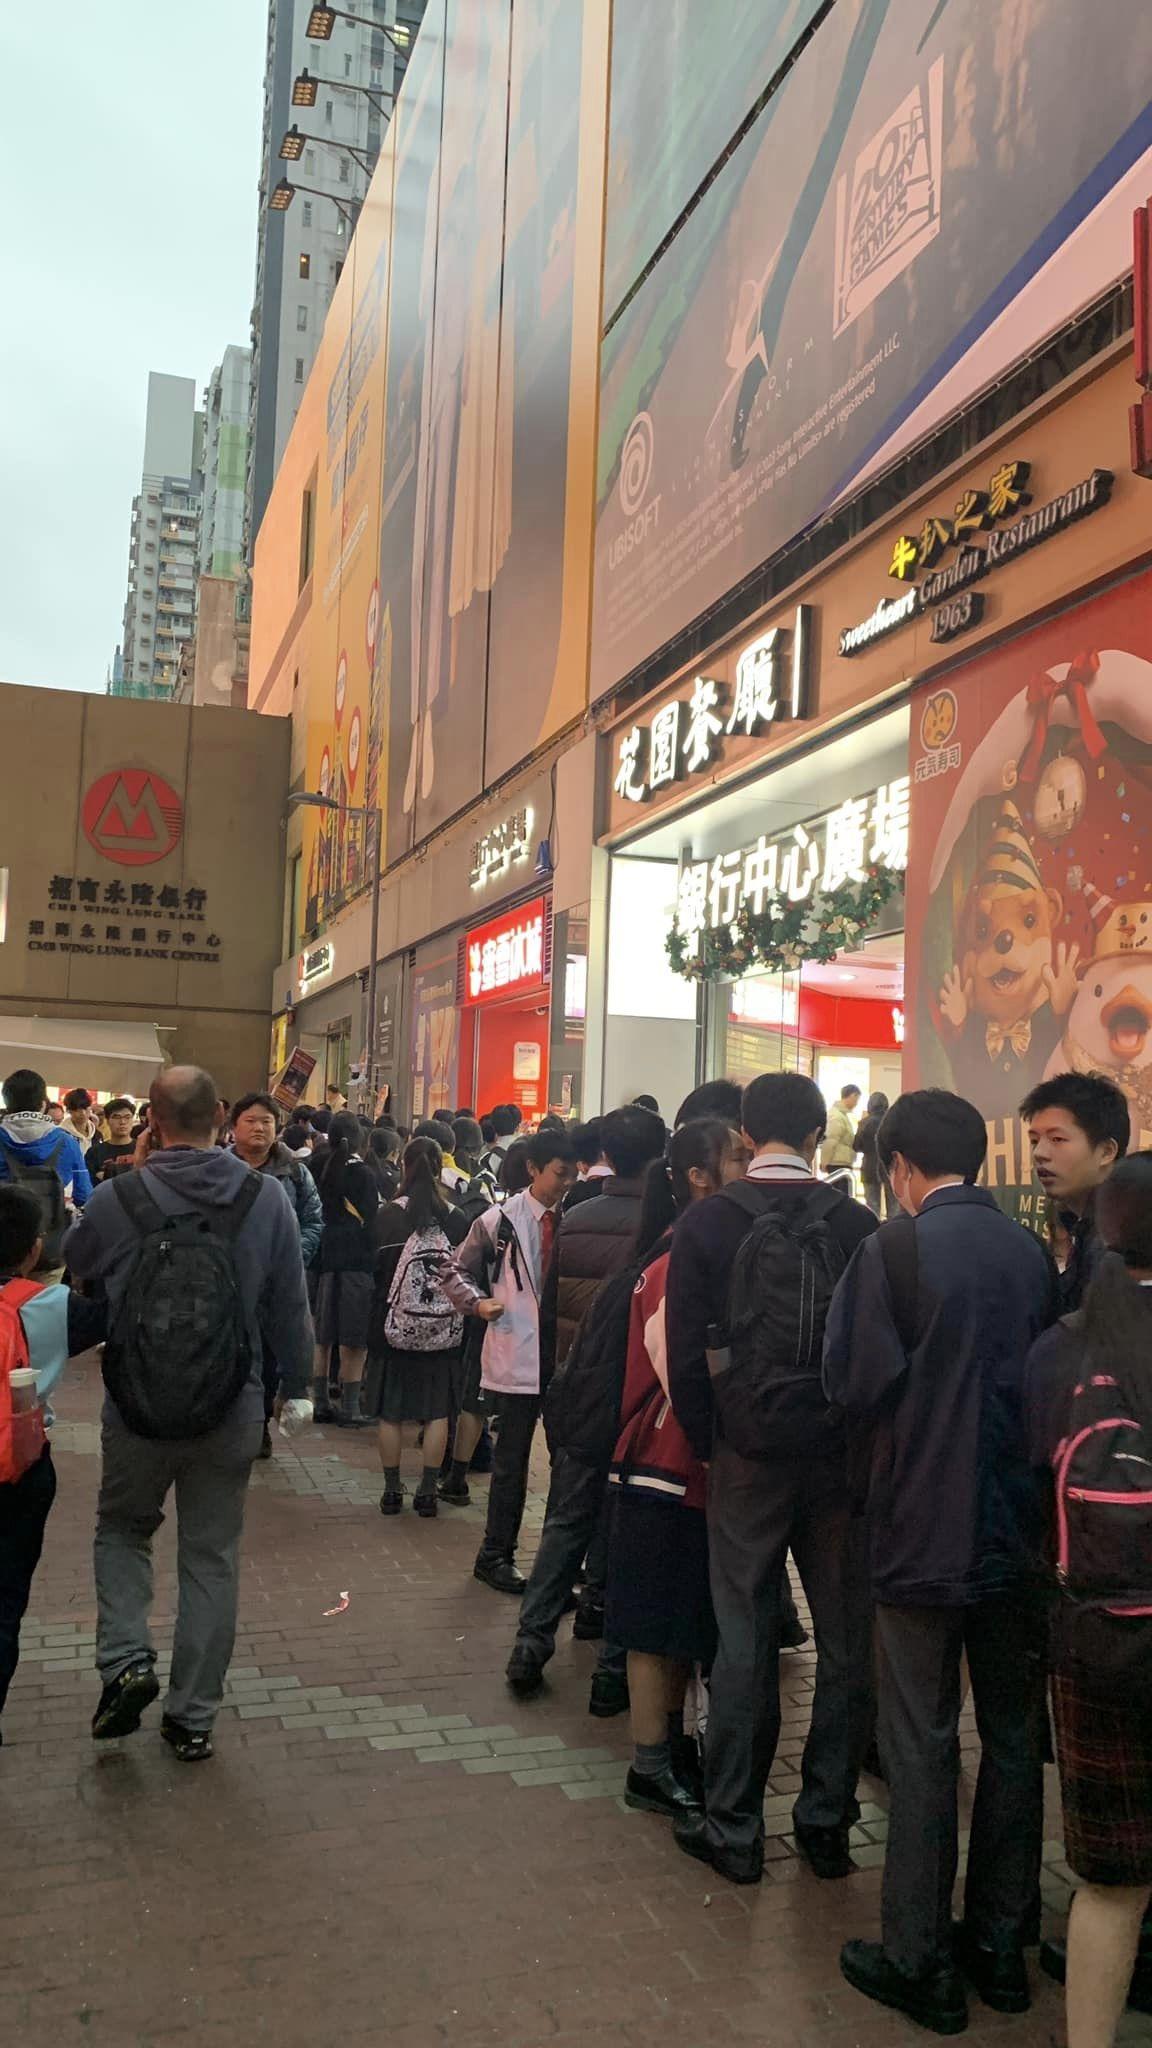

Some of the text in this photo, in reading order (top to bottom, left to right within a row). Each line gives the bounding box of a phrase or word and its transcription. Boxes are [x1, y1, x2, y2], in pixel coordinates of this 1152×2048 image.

[851, 200, 908, 284] GAMES
[829, 350, 882, 409] Entertainment
[837, 378, 875, 424] registered
[609, 494, 661, 570] UBISOFT
[888, 462, 1020, 579] 牛扒之家
[838, 473, 1099, 655] Sweetheart Garden Restaurant
[932, 593, 972, 641] 1963
[676, 776, 910, 936] 銀行中心廣場
[48, 903, 206, 921] CMB WING LUNG BANK
[28, 940, 220, 962] CMB WING LUNG BANK CENTRE
[1019, 1194, 1046, 1214] ME
